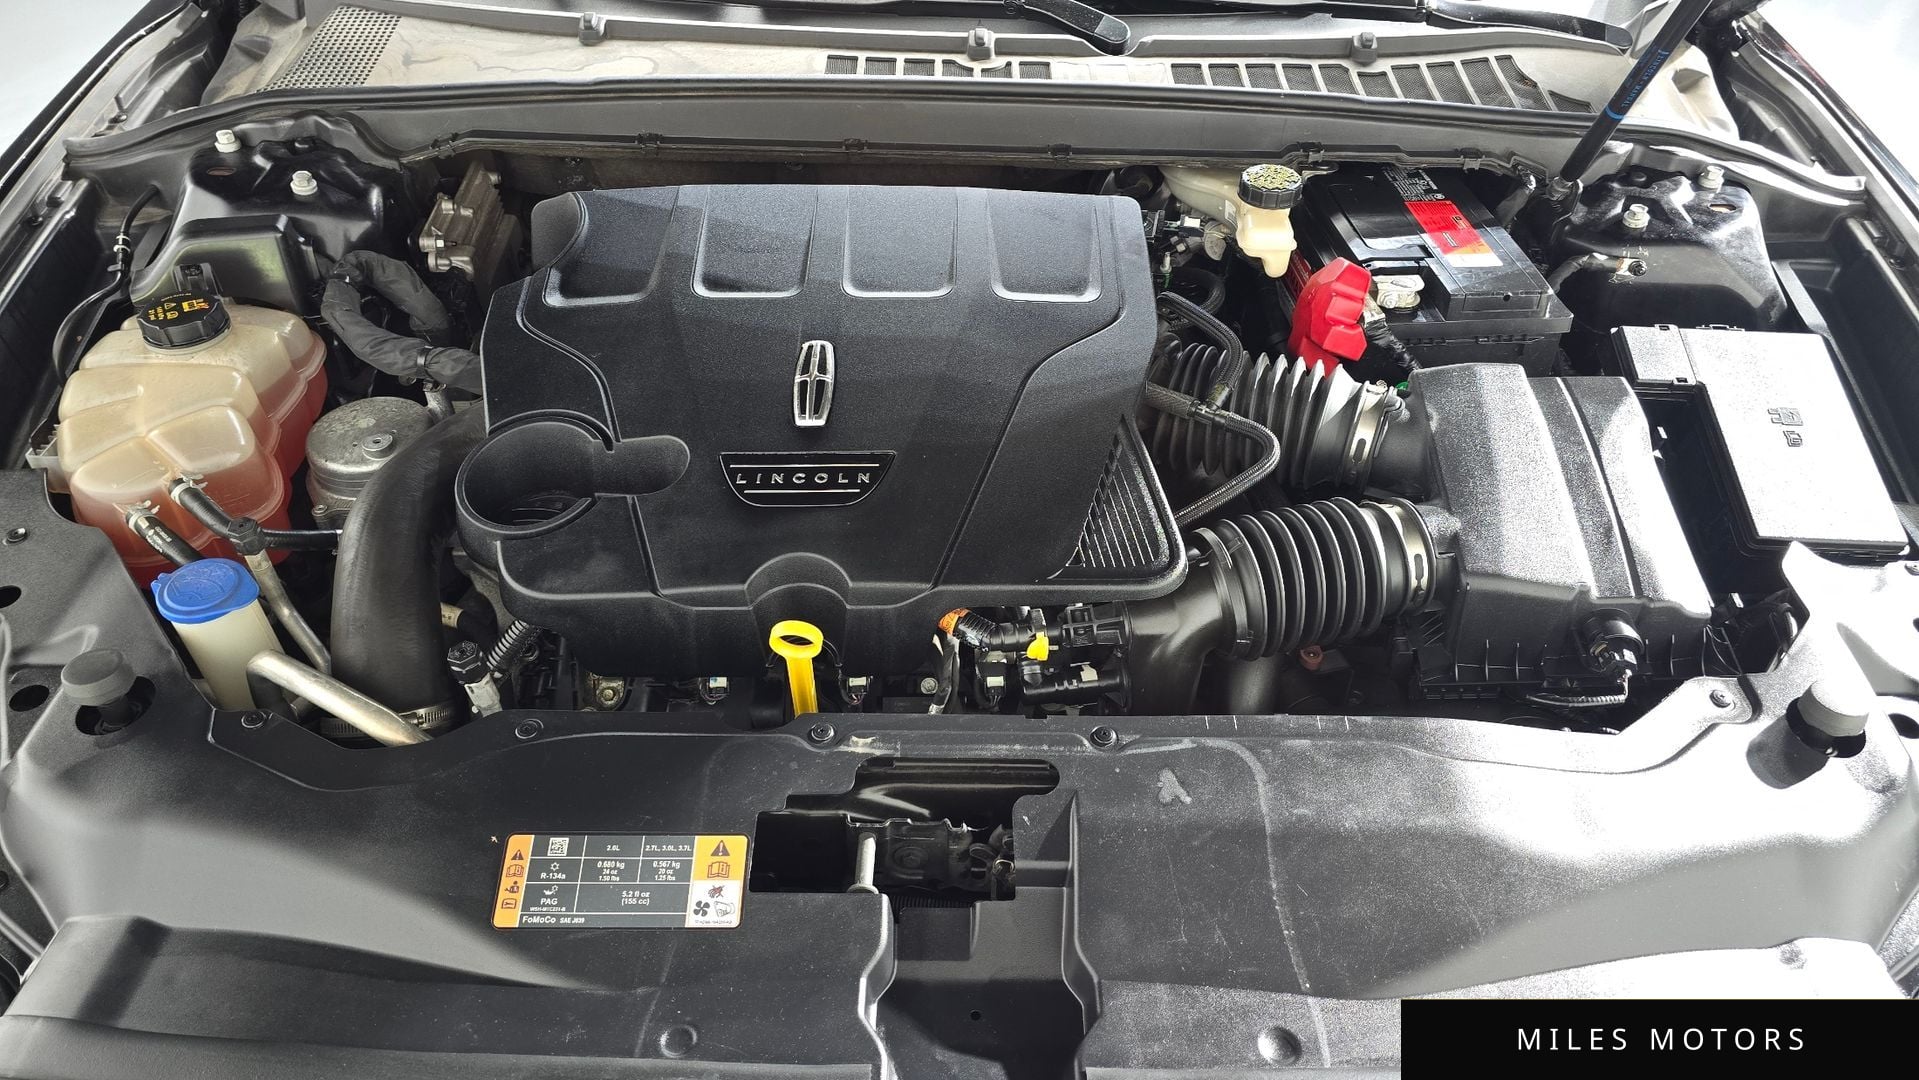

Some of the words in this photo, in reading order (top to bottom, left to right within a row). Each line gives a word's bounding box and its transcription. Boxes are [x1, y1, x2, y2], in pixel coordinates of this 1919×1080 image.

[735, 472, 871, 485] LINCOLN
[616, 860, 625, 870] kg
[671, 860, 681, 870] kg
[540, 872, 566, 880] R-134a
[621, 890, 633, 898] 5.2
[621, 898, 638, 906] (155
[638, 898, 650, 906] cc)
[522, 915, 557, 924] FoMoCo
